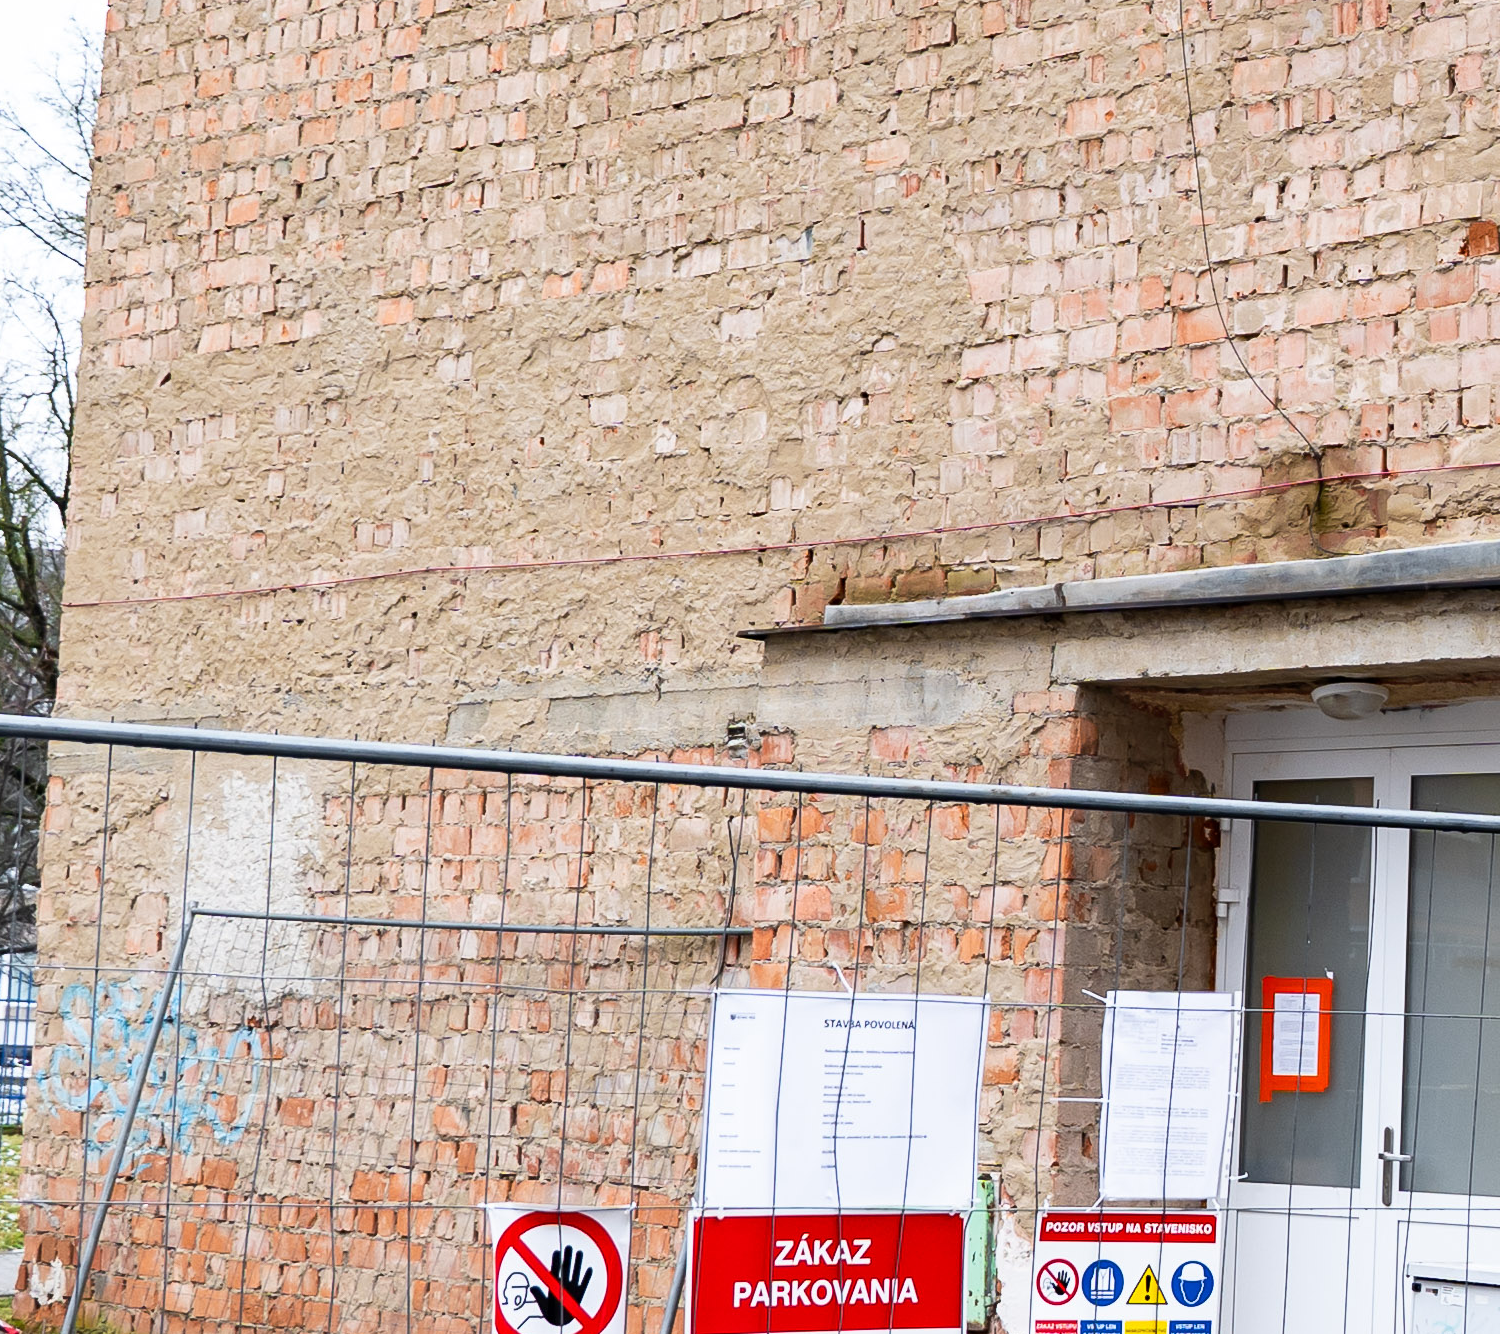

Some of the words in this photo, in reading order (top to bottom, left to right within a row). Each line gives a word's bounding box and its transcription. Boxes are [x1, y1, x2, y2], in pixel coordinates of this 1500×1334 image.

[824, 1019, 861, 1028] STAVBA
[864, 1019, 914, 1029] POVOLENÁ
[1045, 1222, 1084, 1233] POZOR
[1087, 1222, 1123, 1234] VSTUP
[1125, 1223, 1141, 1234] NA
[1143, 1223, 1212, 1235] STAVENISKO
[773, 1233, 872, 1267] ZÁKAZ
[733, 1278, 919, 1308] PARKOVANIA
